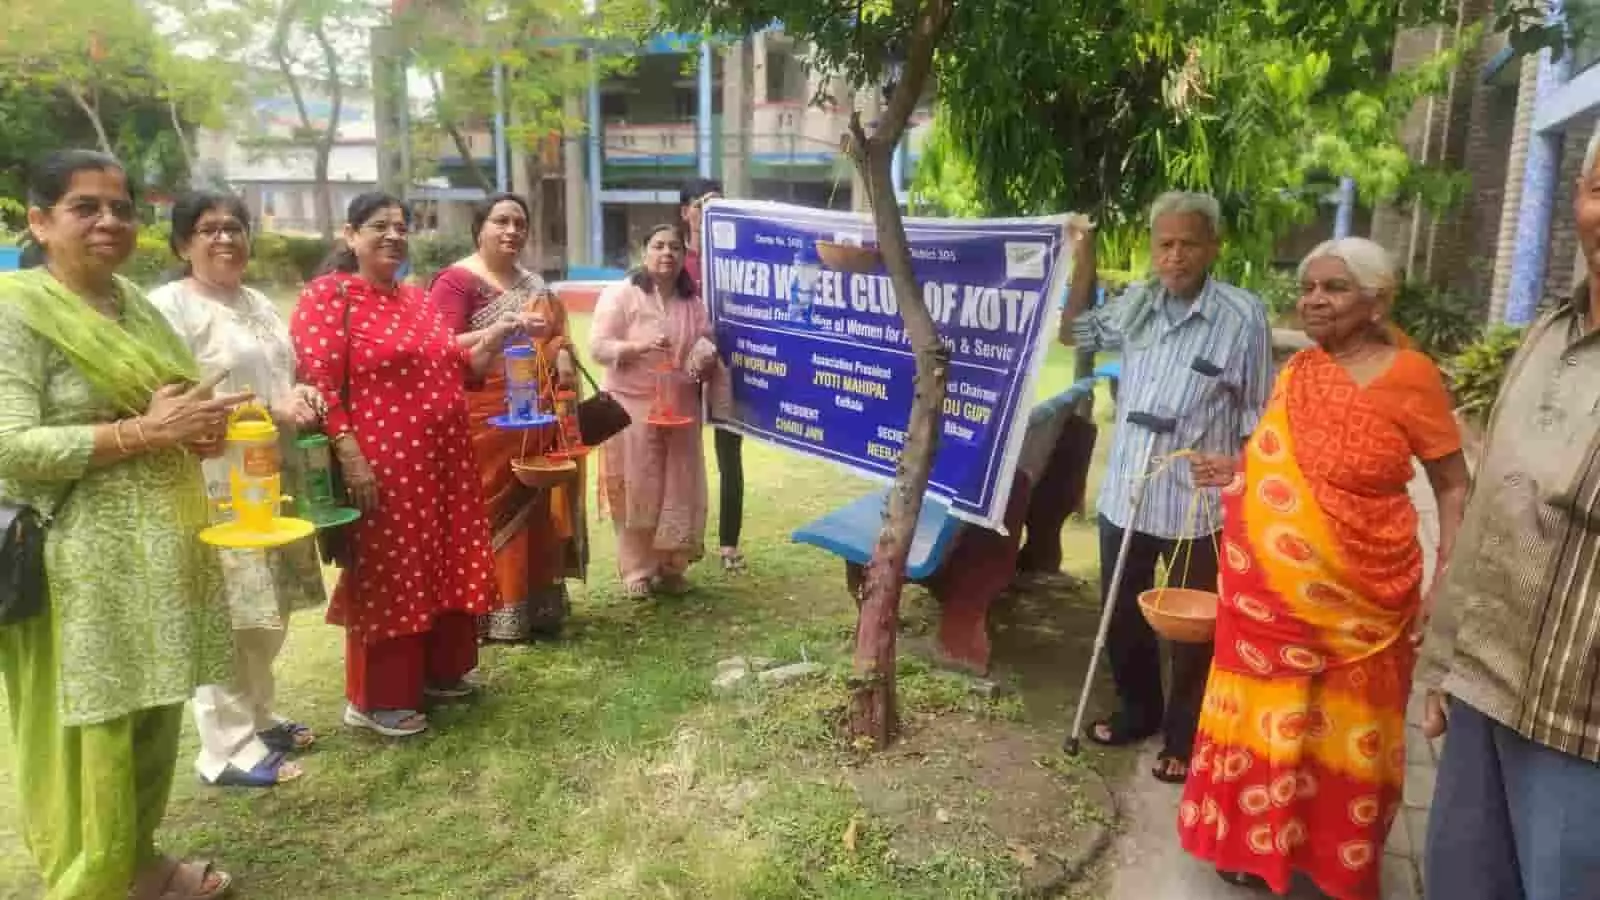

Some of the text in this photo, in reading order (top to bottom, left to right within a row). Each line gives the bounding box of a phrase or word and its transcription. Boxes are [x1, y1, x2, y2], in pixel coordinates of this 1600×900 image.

[714, 256, 770, 297] INNER
[773, 263, 847, 309] WEEL
[851, 273, 898, 315] CLU
[923, 281, 957, 325] OF
[847, 318, 882, 340] Women
[885, 324, 900, 344] for
[813, 370, 840, 388] JYOTI
